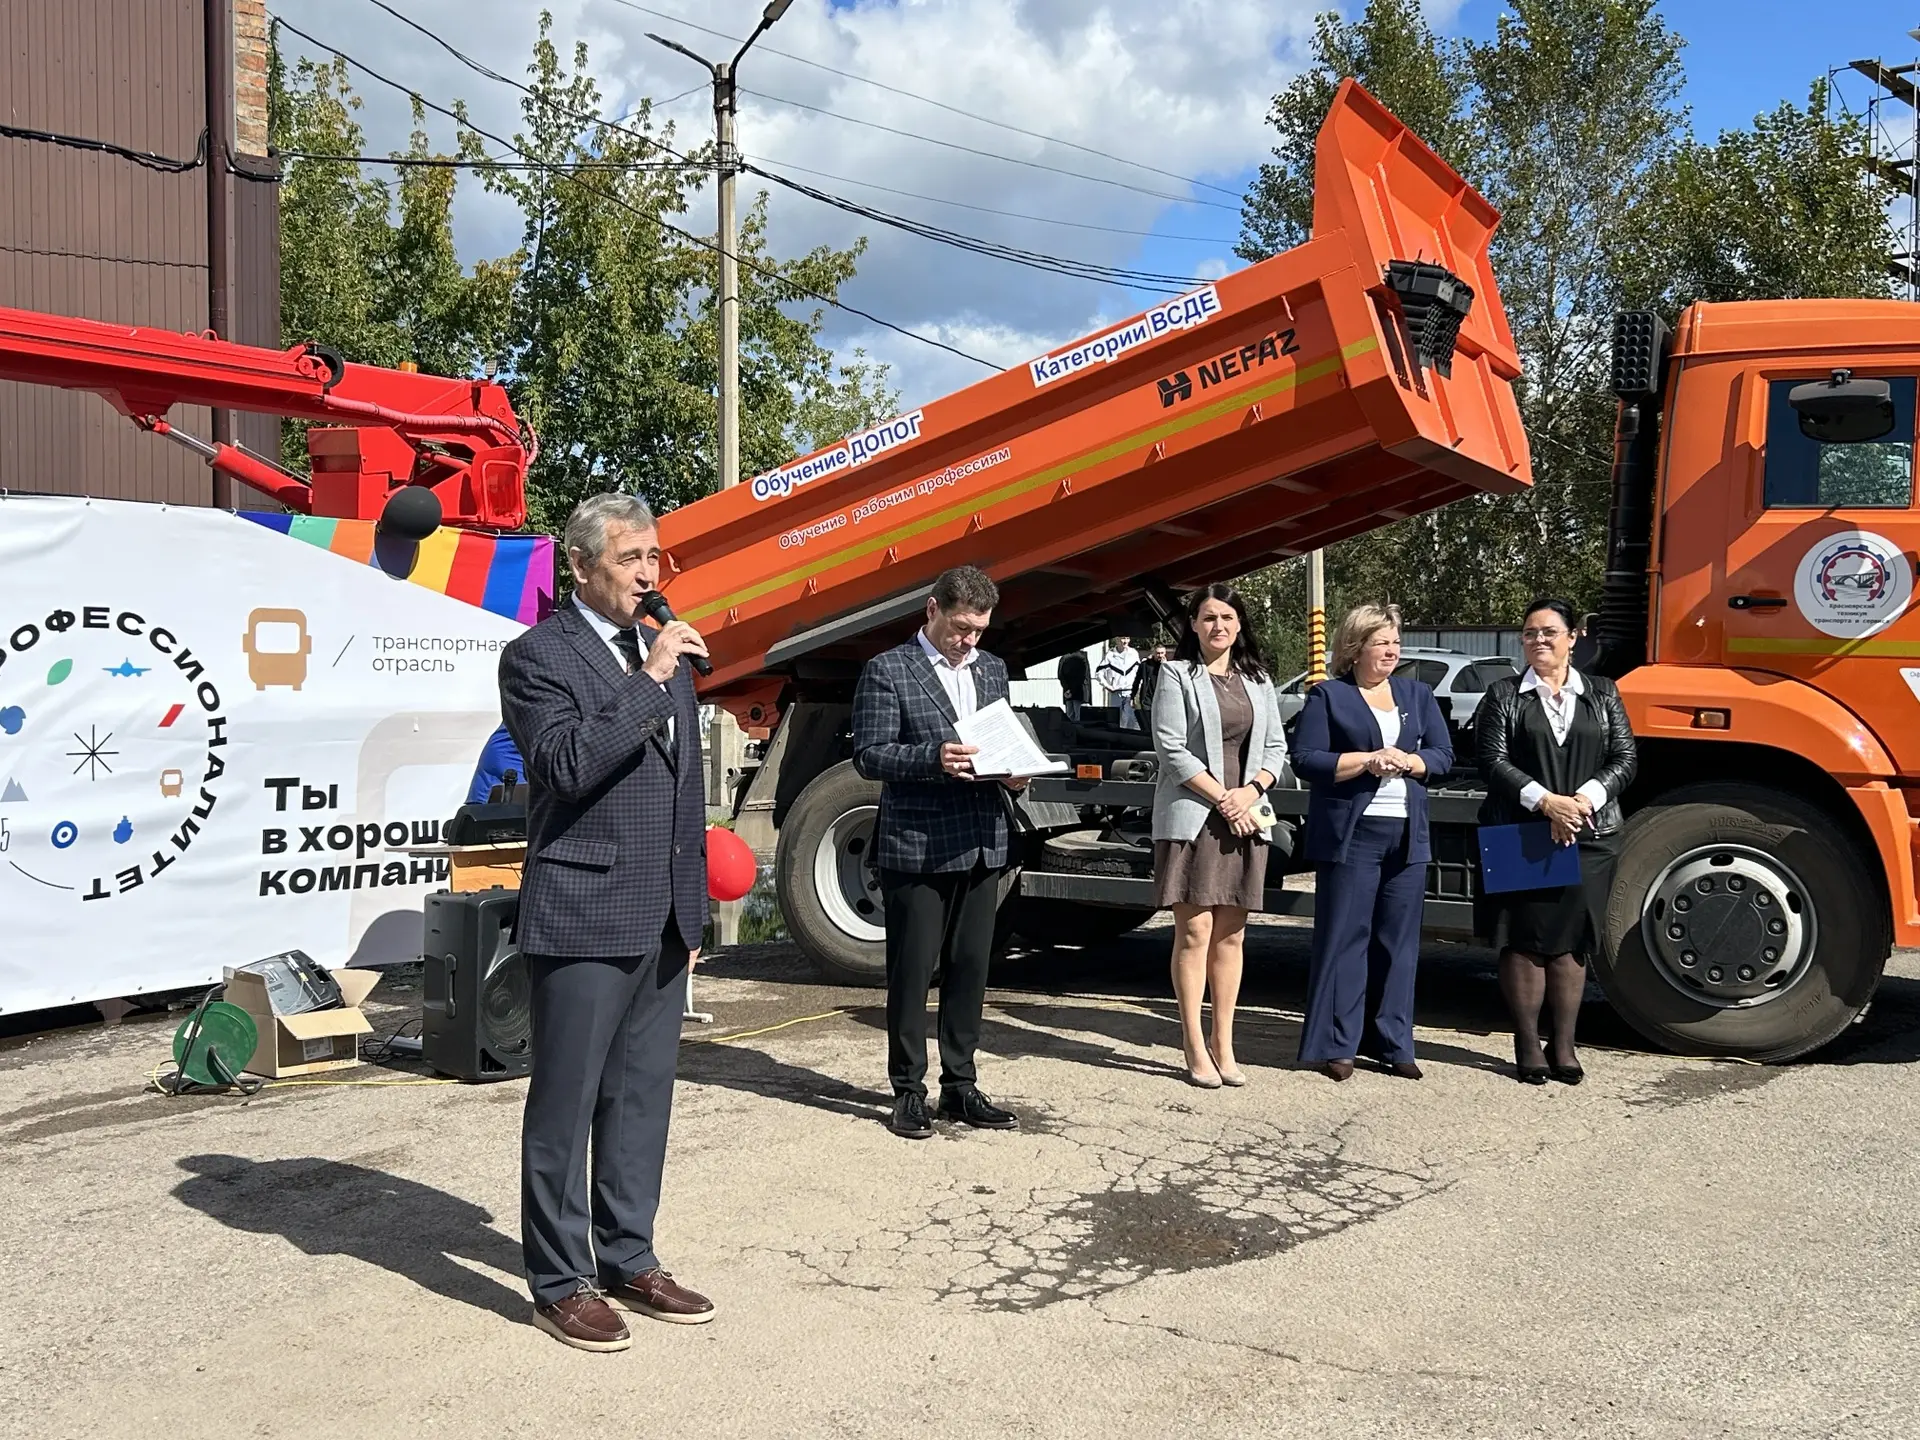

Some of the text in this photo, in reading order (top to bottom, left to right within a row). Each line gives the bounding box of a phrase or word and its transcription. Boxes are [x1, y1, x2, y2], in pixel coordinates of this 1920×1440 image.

[1033, 290, 1217, 382] Категории ВСДЕ
[1197, 328, 1301, 390] NEFAZ
[754, 414, 921, 496] Обучение ДОПОГ
[779, 448, 1011, 549] Обучение рабочим профессиям
[372, 636, 509, 655] транспортная
[372, 658, 455, 675] отрасль
[264, 777, 339, 812] Ты
[262, 828, 289, 855] в
